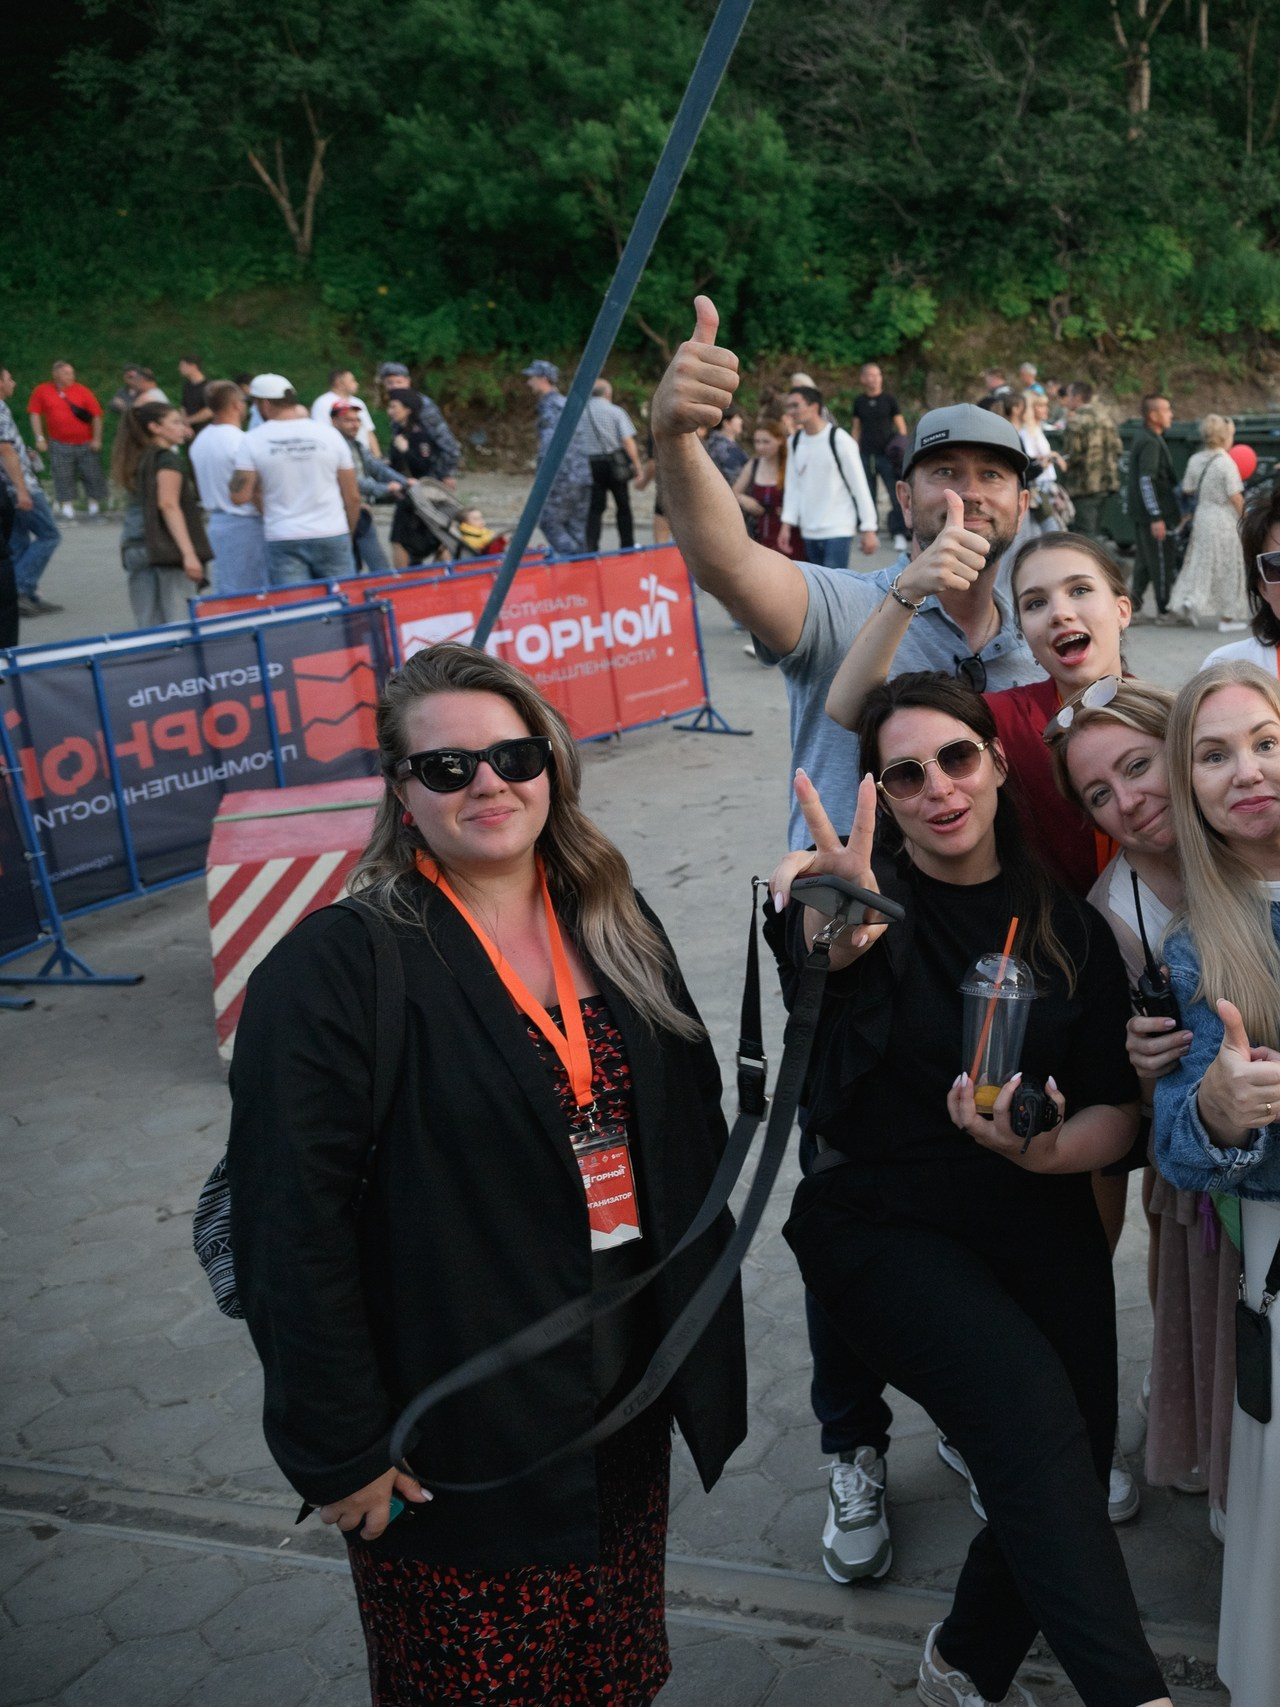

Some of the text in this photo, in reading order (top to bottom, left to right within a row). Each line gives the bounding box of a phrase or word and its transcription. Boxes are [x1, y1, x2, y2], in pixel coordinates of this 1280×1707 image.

[922, 432, 946, 444] SIMMS
[499, 593, 588, 620] ЕСТИВАЛЬ
[591, 1164, 627, 1183] ГОРНОЙ
[587, 1191, 633, 1209] ГАНИЗАТОР
